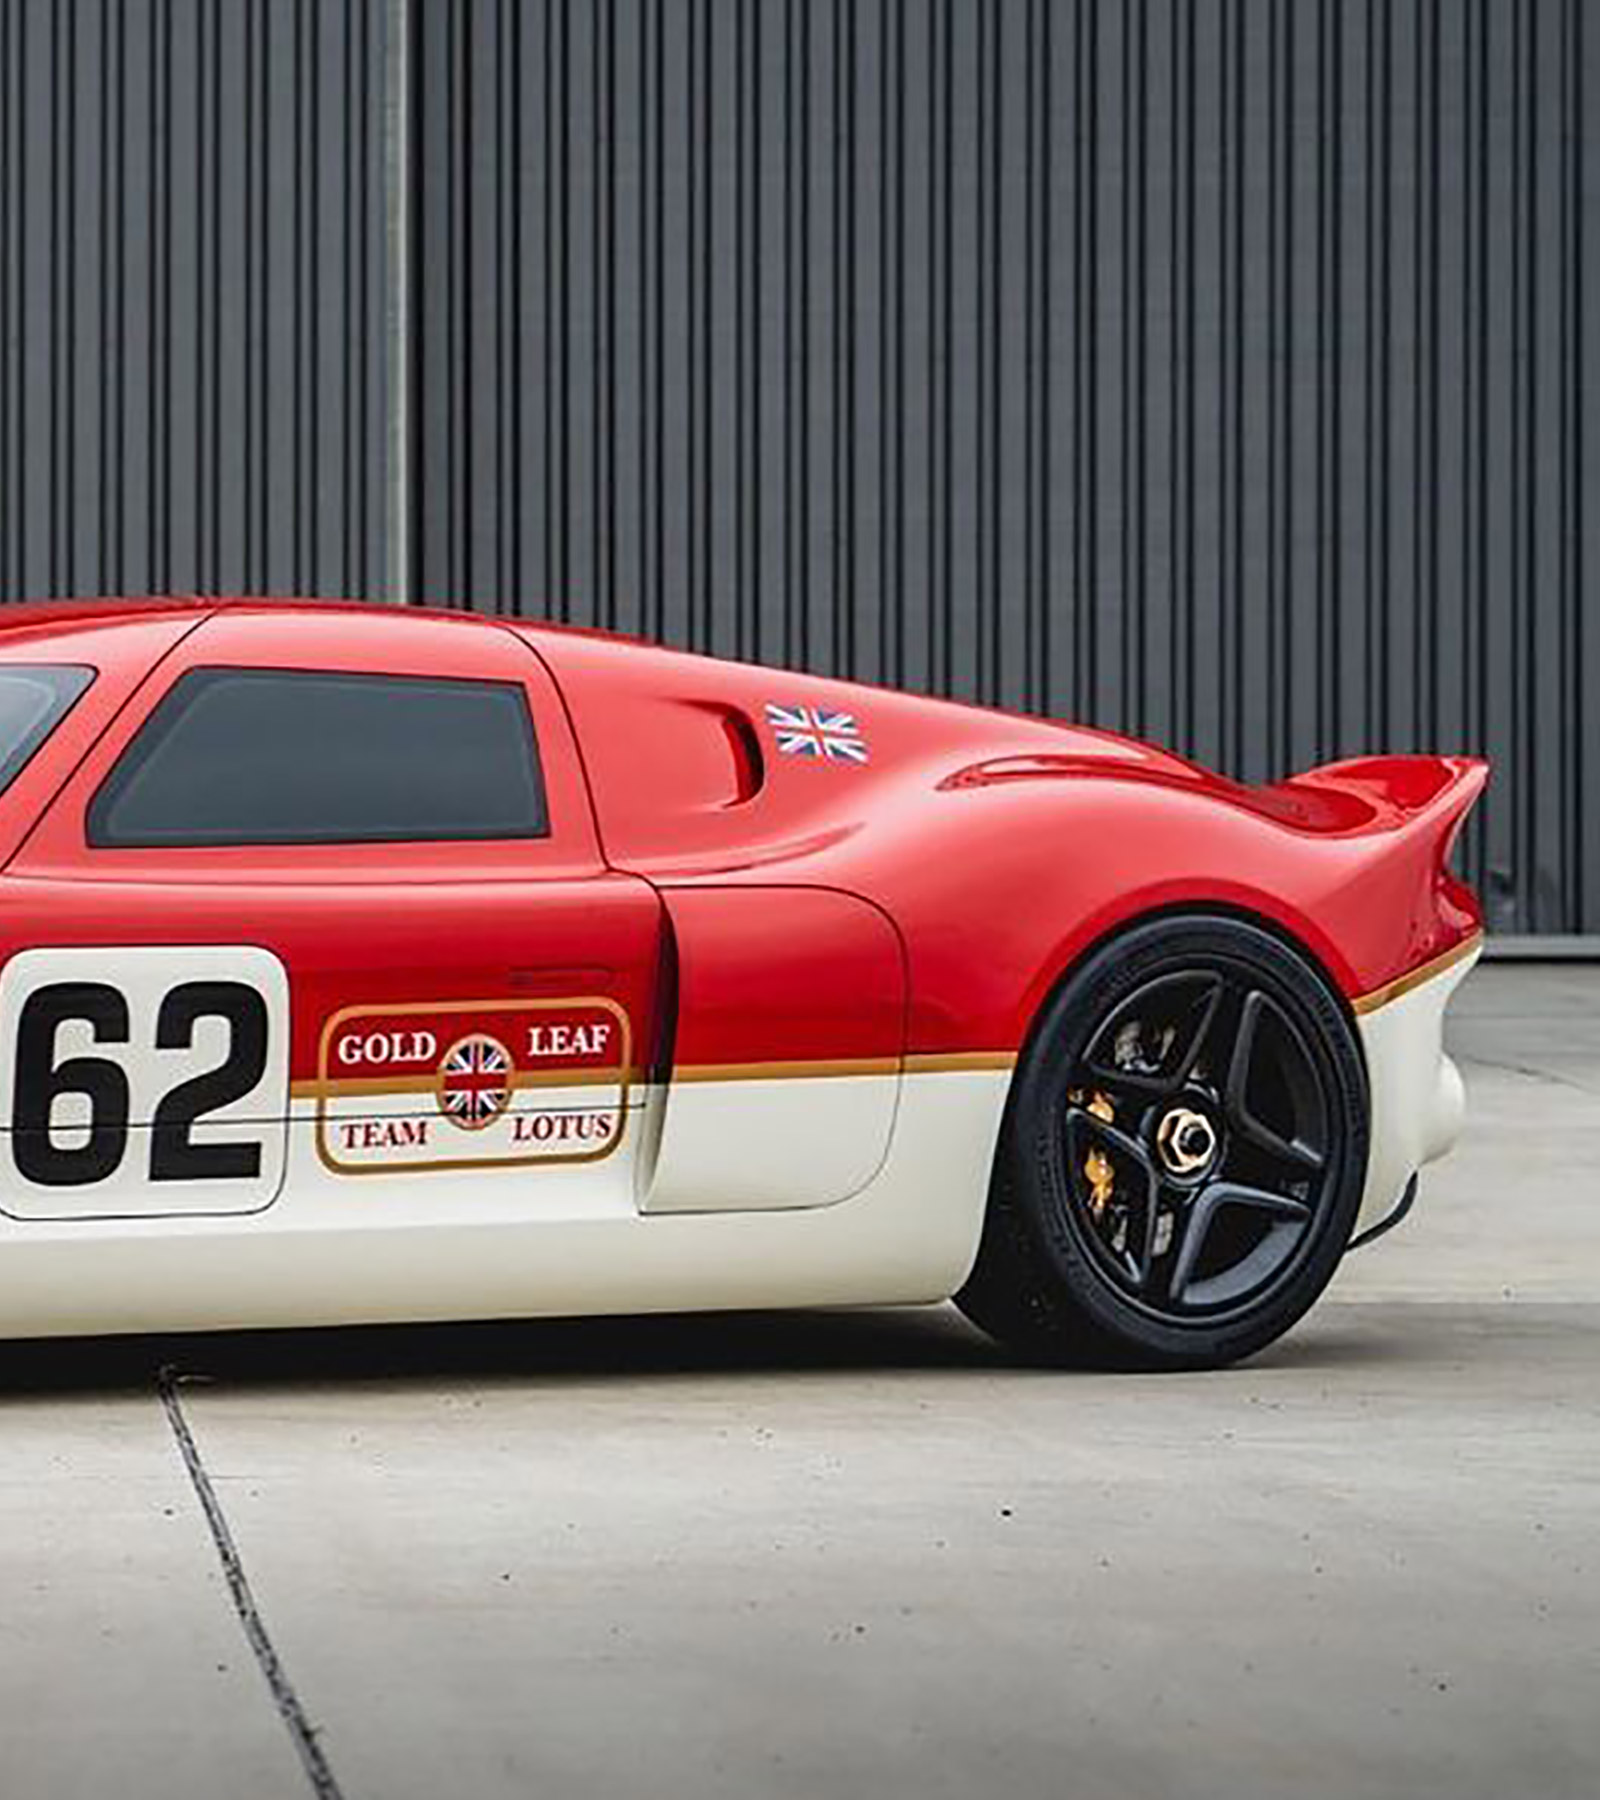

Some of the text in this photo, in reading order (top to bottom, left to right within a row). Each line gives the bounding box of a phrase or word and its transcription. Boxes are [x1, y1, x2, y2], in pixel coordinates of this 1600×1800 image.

[337, 1024, 610, 1064] GOLD LEAF
[11, 981, 268, 1187] 62
[340, 1114, 612, 1149] TEAM LOTUS
